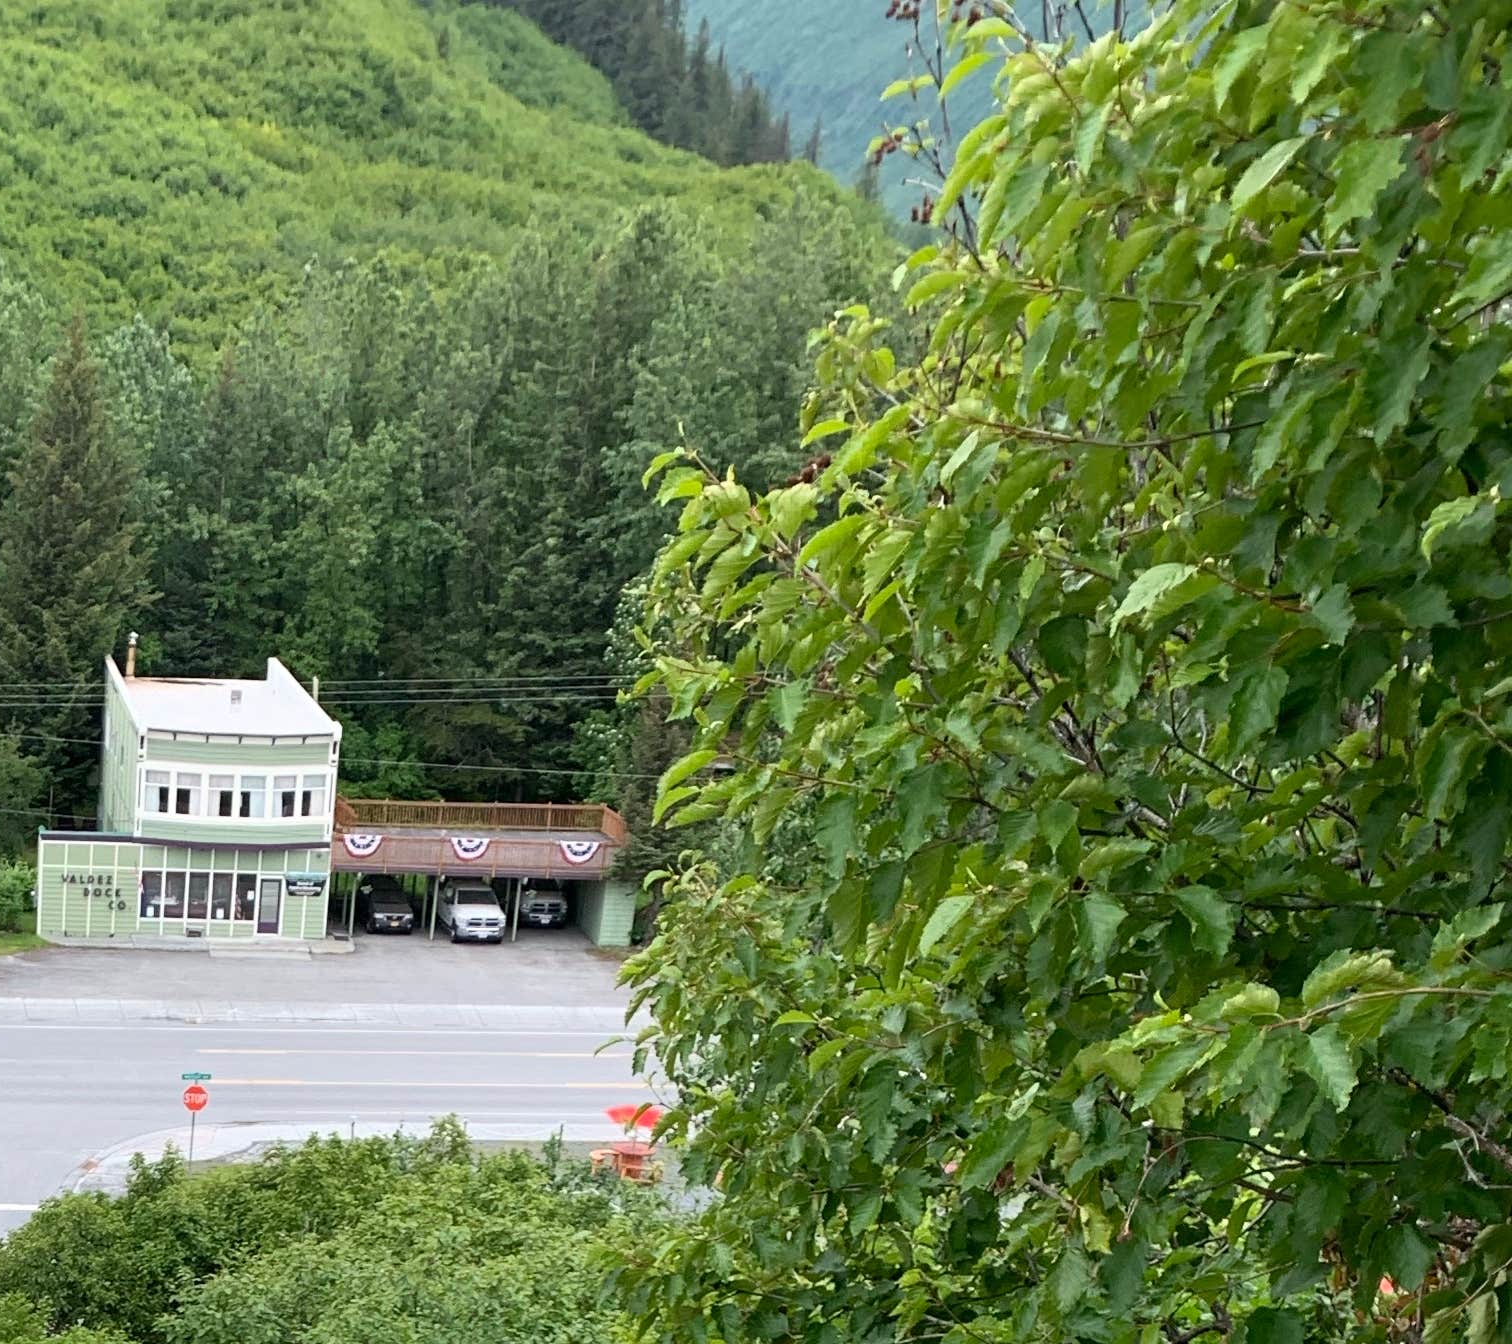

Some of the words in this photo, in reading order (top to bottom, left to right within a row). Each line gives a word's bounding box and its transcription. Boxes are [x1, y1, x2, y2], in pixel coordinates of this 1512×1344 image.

[61, 874, 113, 885] VALDEZ
[83, 887, 121, 897] DOCK
[184, 1093, 207, 1104] STOP
